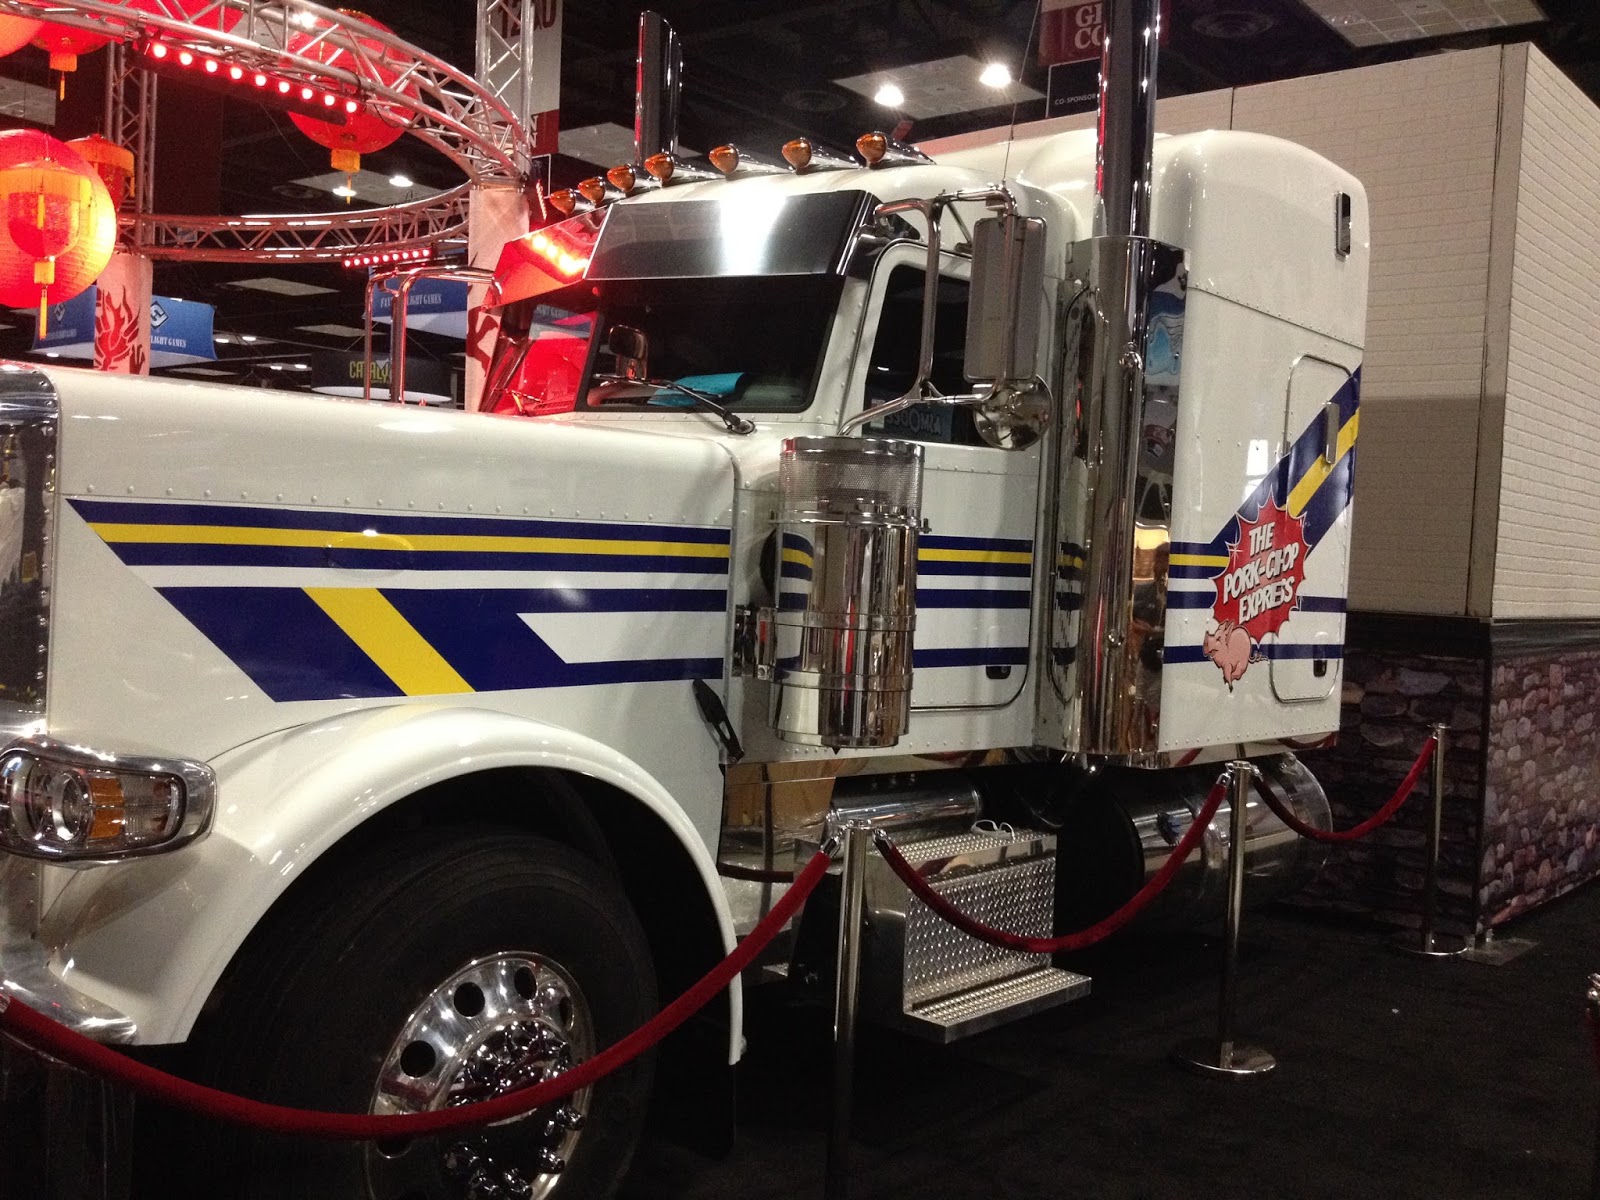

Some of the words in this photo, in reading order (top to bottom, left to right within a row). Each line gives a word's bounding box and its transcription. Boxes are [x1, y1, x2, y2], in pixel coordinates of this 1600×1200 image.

[150, 336, 168, 345] LIGHT
[168, 337, 187, 348] GAMES
[1248, 522, 1276, 558] THE
